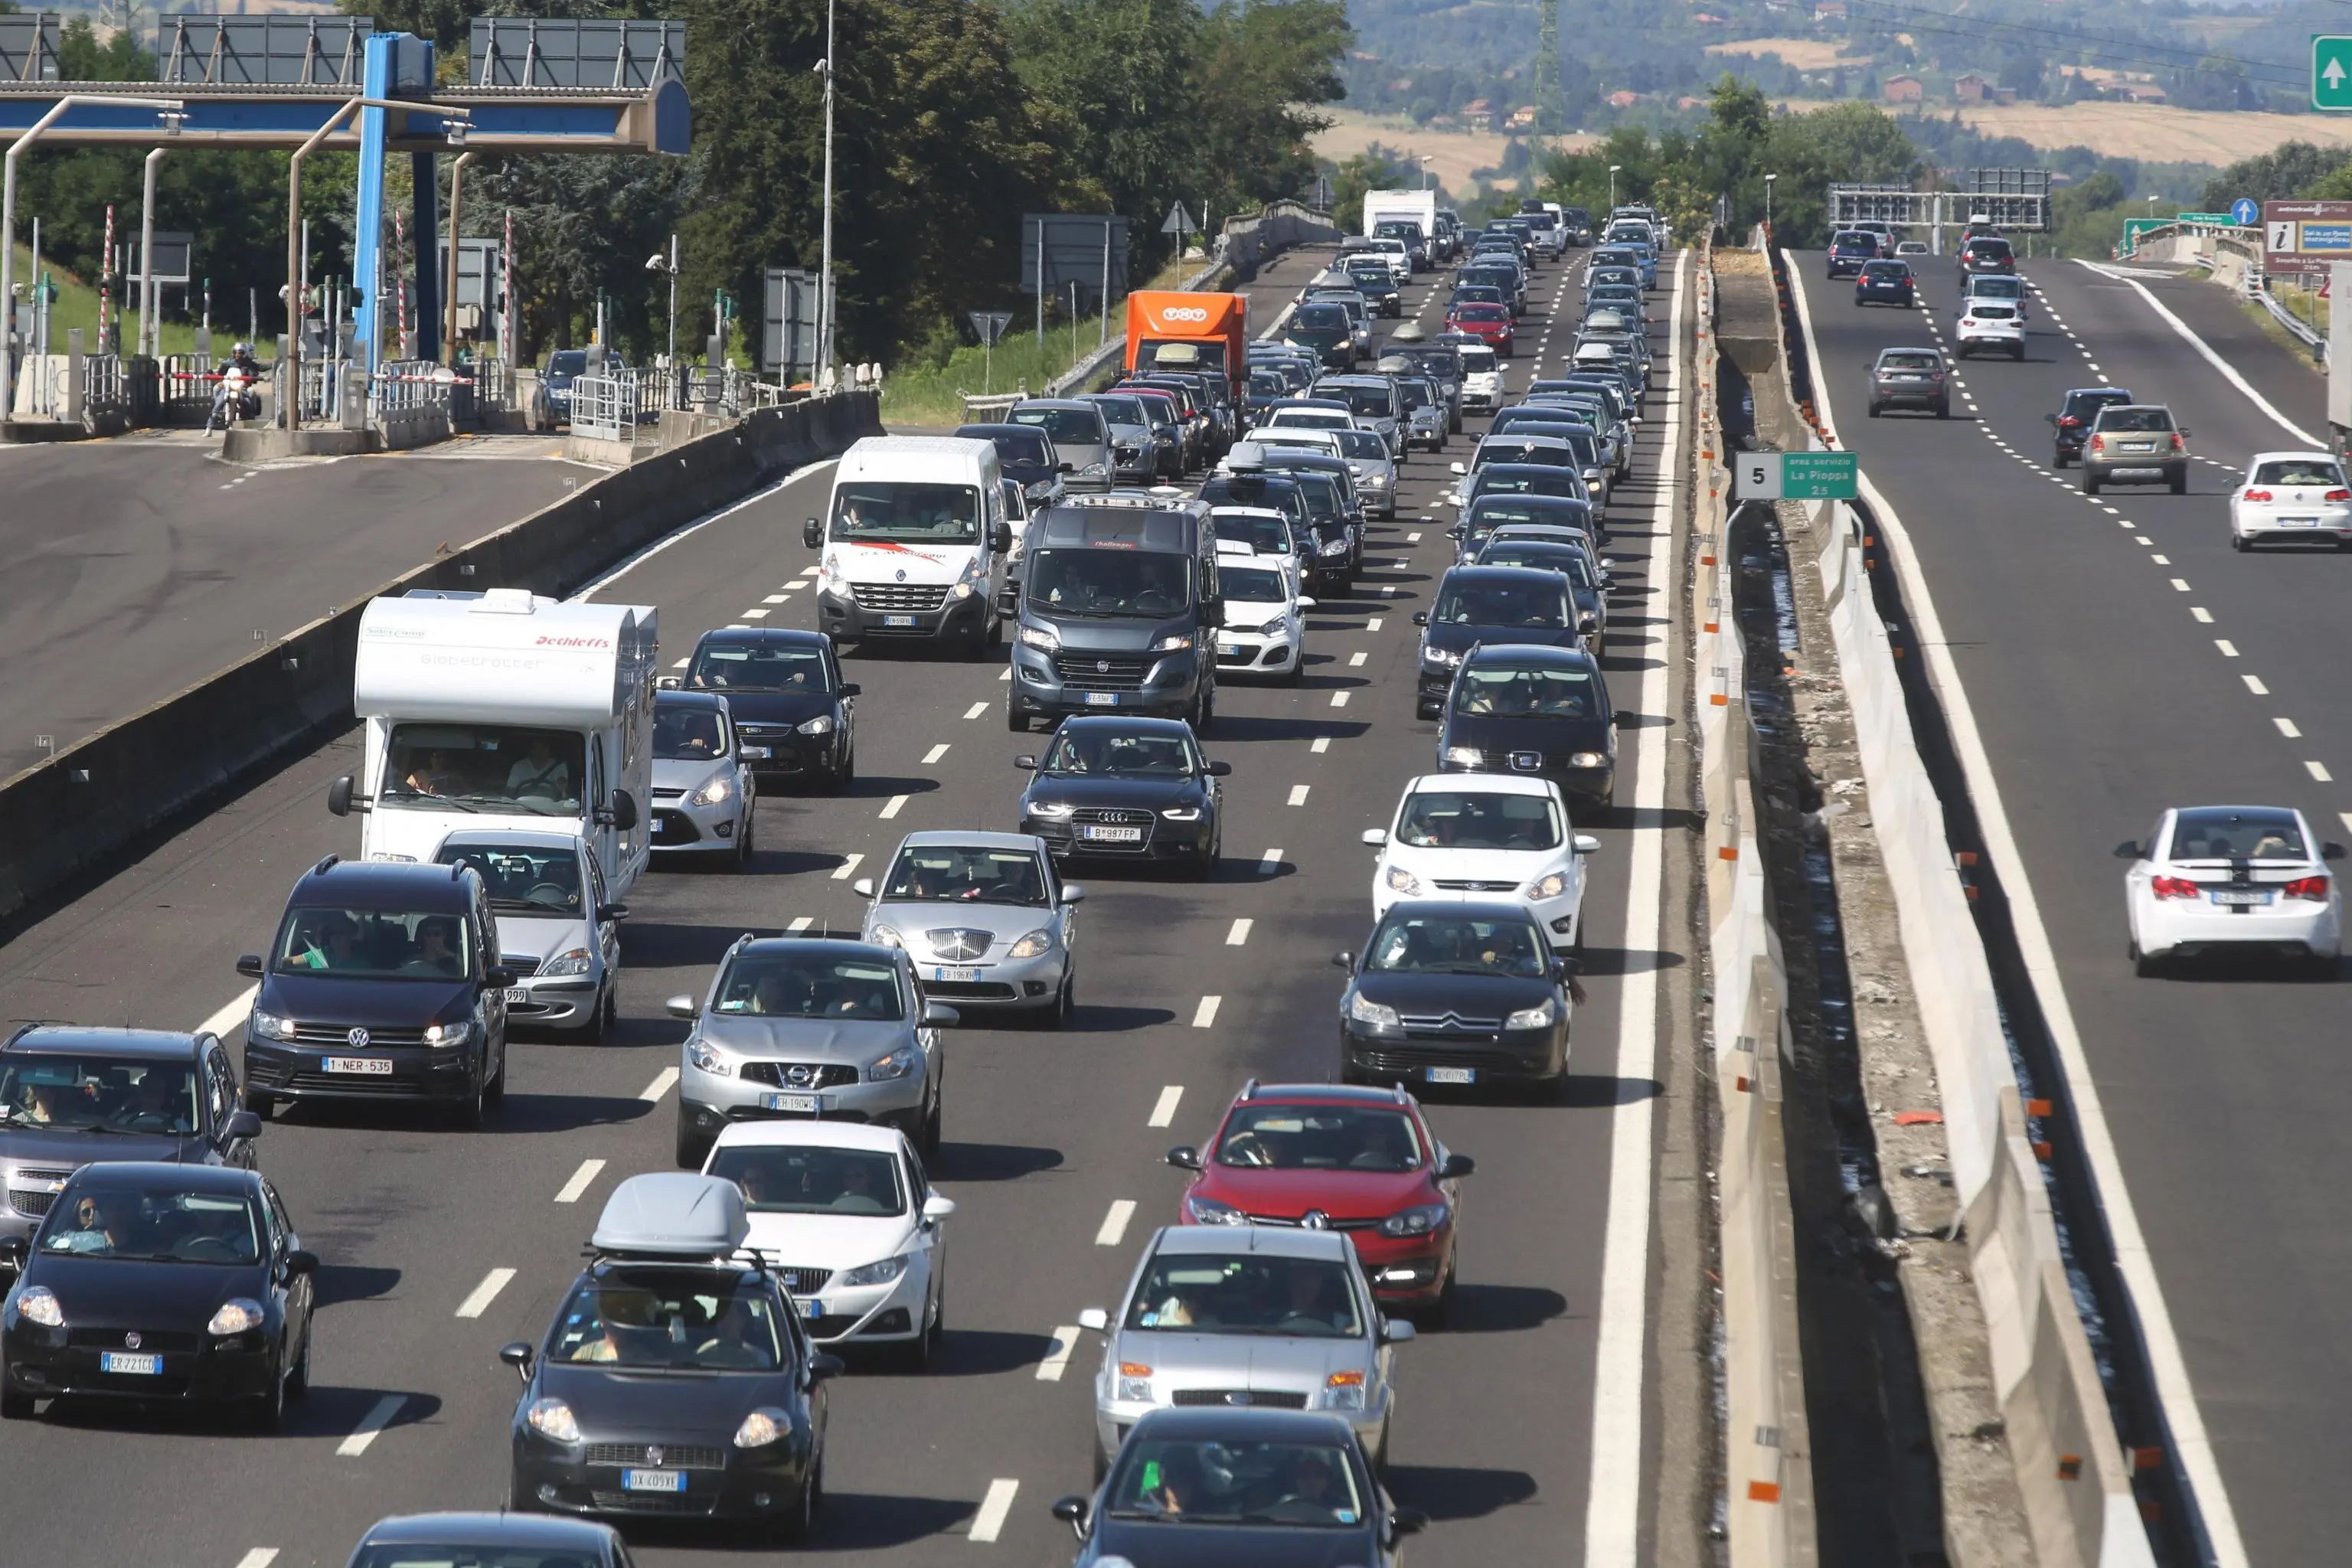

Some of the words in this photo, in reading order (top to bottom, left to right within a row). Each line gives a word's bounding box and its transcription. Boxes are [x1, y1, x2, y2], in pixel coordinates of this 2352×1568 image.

[1163, 308, 1207, 322] TNT
[1753, 468, 1765, 485] 5
[1791, 471, 1805, 480] La
[1809, 470, 1849, 482] Pioppa
[536, 635, 610, 648] Dethleffs
[421, 654, 546, 668] Globetrotter
